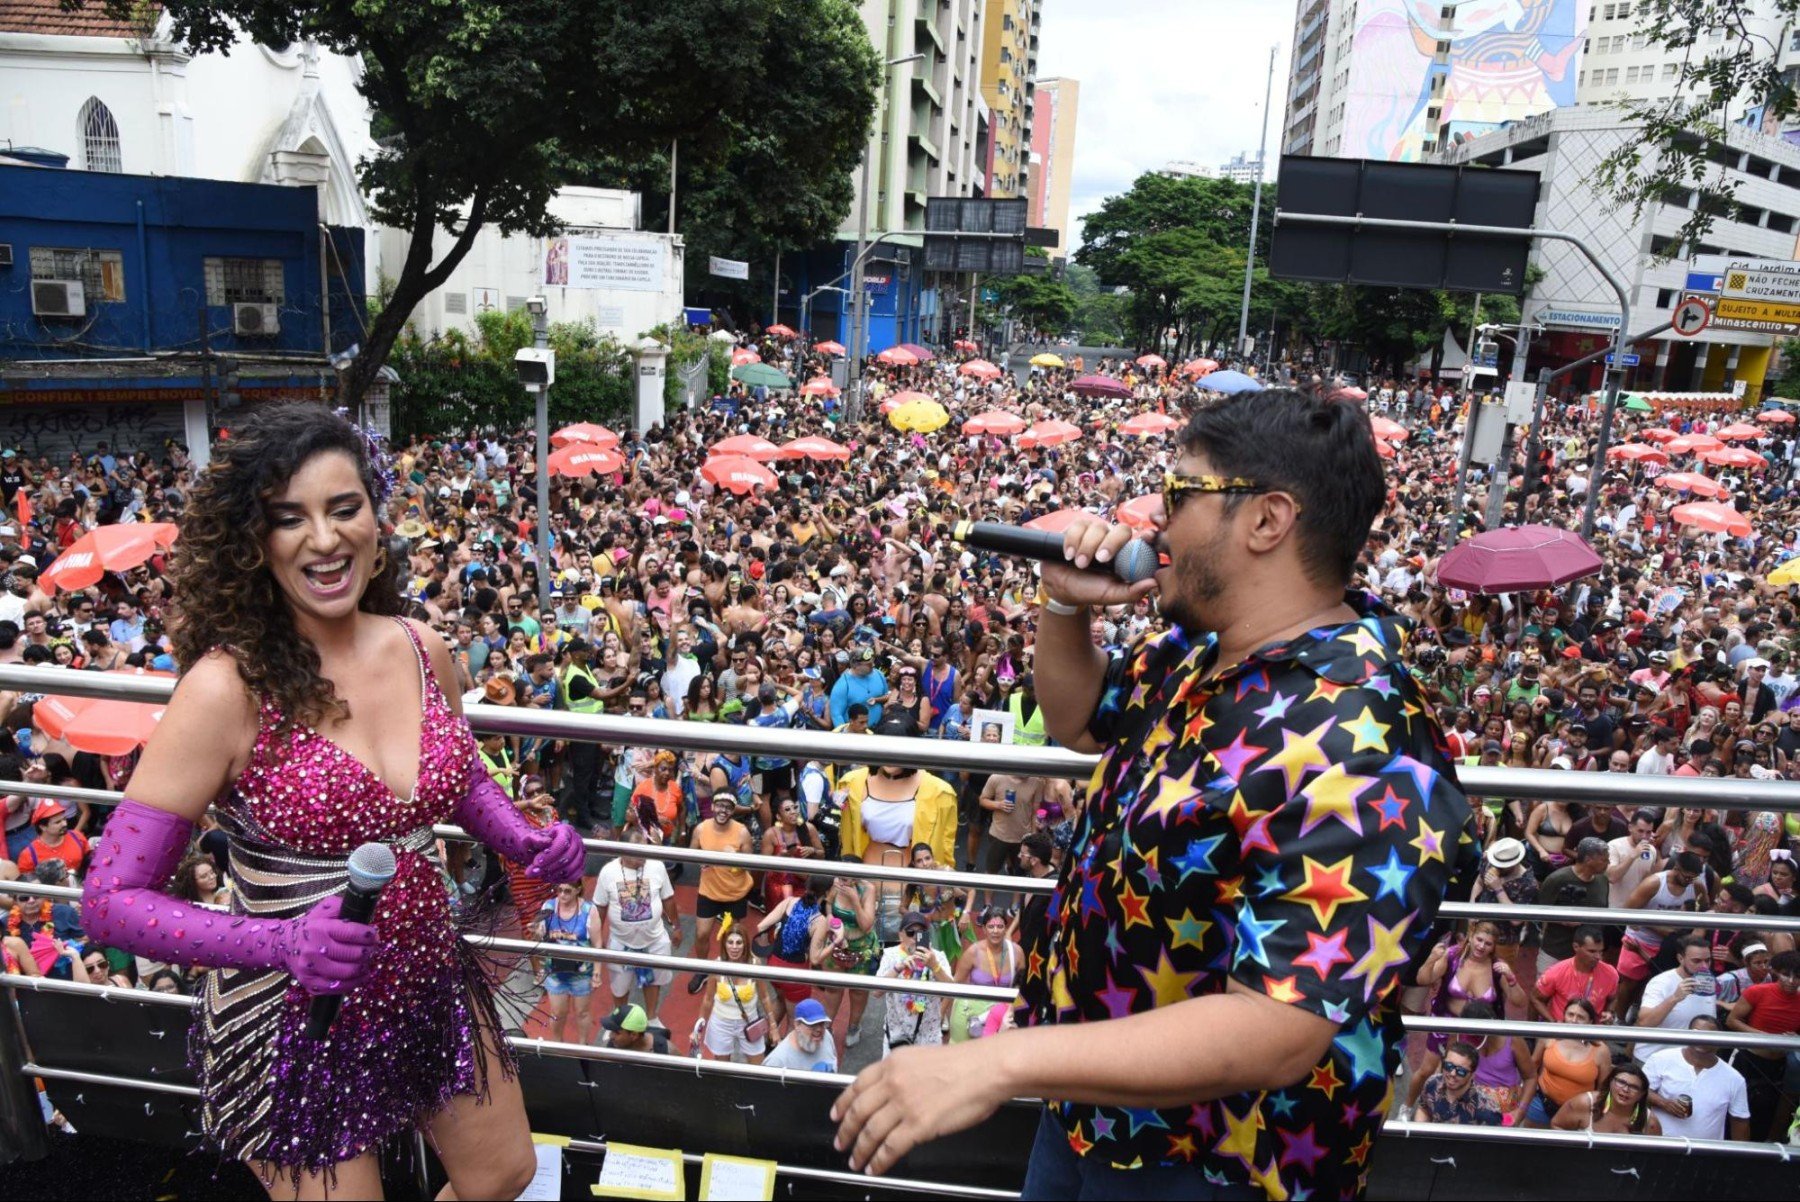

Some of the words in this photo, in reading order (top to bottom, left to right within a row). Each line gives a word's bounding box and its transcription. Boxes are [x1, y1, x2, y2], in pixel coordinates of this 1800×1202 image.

[1749, 273, 1768, 284] NÃO
[1772, 277, 1800, 287] FECHE
[1746, 286, 1800, 298] CRUZAMENT
[1721, 303, 1757, 315] SUJEITO
[1549, 312, 1620, 324] ESTACIONAMENTO
[1714, 317, 1782, 330] Minascentro
[98, 390, 156, 402] SEMPRE
